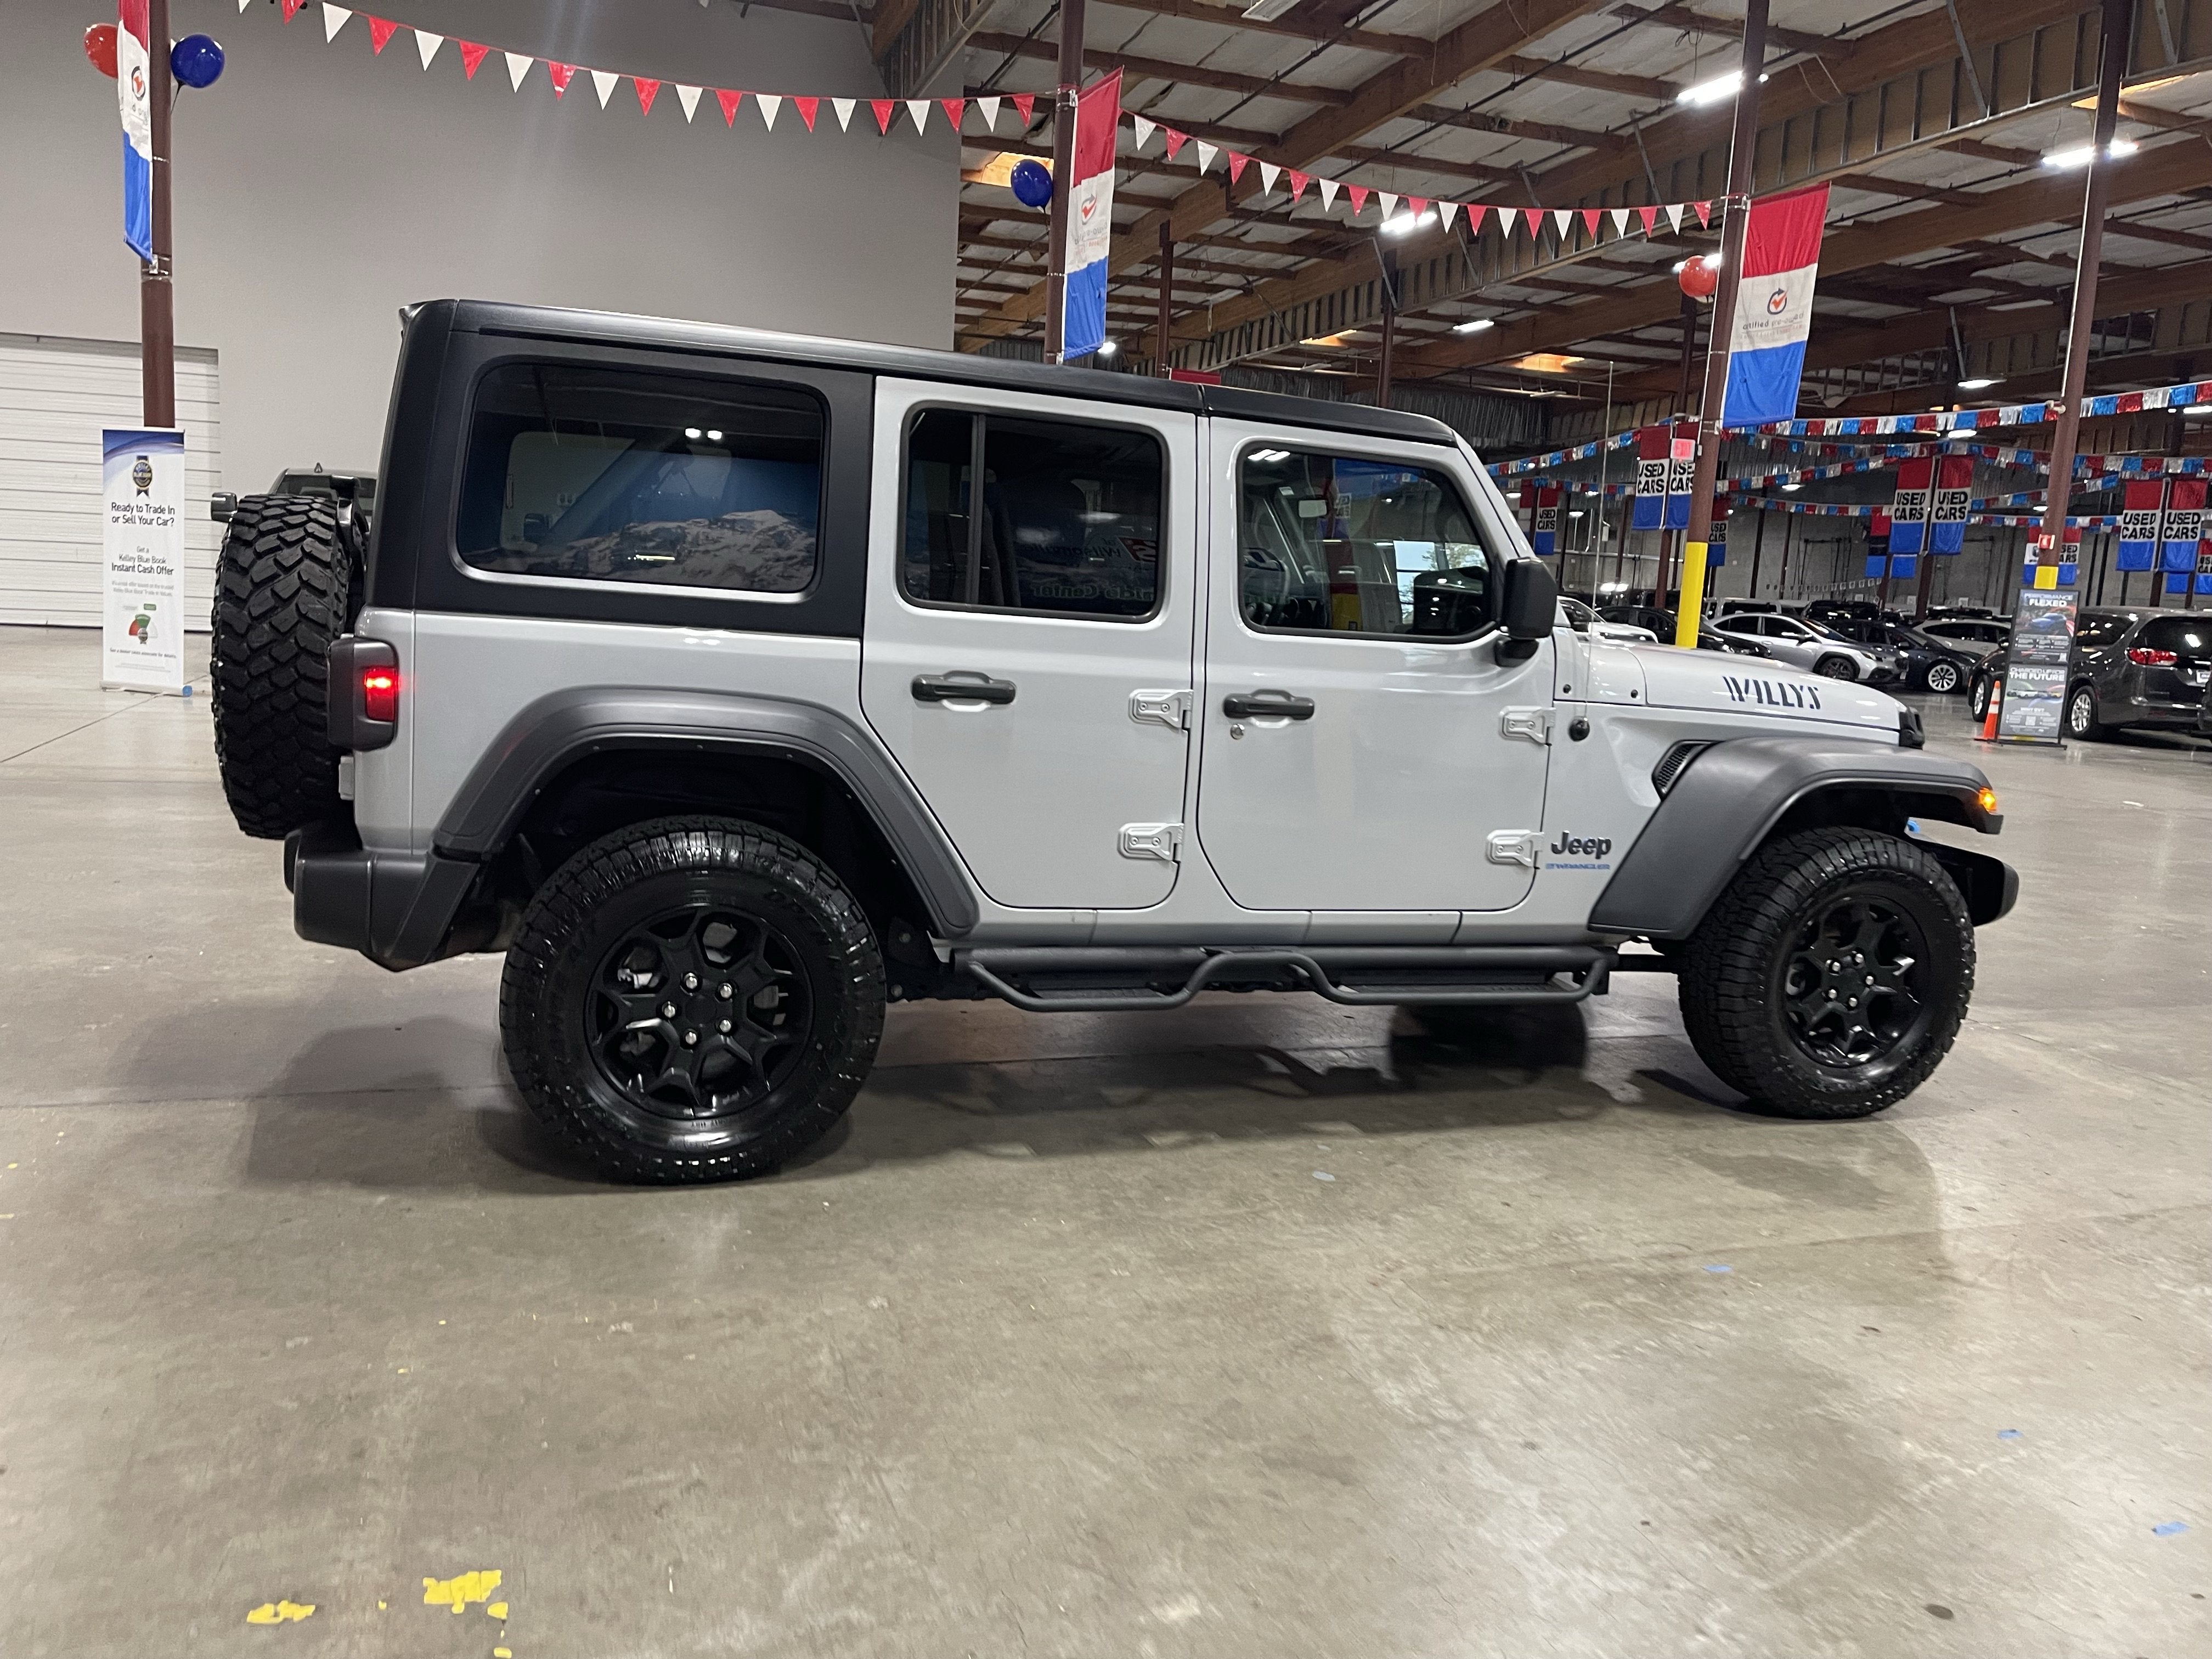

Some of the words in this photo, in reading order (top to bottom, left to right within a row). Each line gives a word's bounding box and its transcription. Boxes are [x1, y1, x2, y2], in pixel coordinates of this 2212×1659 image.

[1673, 462, 1694, 476] USE
[1637, 478, 1665, 494] CARS
[1896, 492, 1926, 506] USED
[111, 502, 134, 515] Ready
[136, 504, 143, 512] to
[145, 504, 166, 514] Trade
[168, 505, 175, 515] In
[1539, 509, 1556, 519] USED
[1894, 506, 1924, 521] CARS
[1935, 506, 1967, 520] CARS
[122, 514, 136, 524] Sell
[138, 515, 155, 525] Your
[156, 516, 174, 527] Car?
[2123, 512, 2157, 526] USED
[2167, 512, 2201, 525] USED
[2121, 527, 2155, 539] CARS
[2164, 526, 2199, 539] CARS
[2060, 544, 2078, 553] SED
[119, 553, 136, 564] Kelley
[137, 555, 150, 563] Blue
[151, 555, 167, 564] Book
[2059, 554, 2076, 563] ARS
[111, 562, 136, 572] Instant
[137, 564, 155, 574] Cash
[156, 566, 174, 575] Offer
[2029, 598, 2067, 607] FLEXED
[2029, 673, 2065, 681] FUTURE
[1722, 675, 1821, 709] WILLYS
[1551, 830, 1611, 860] Jeep
